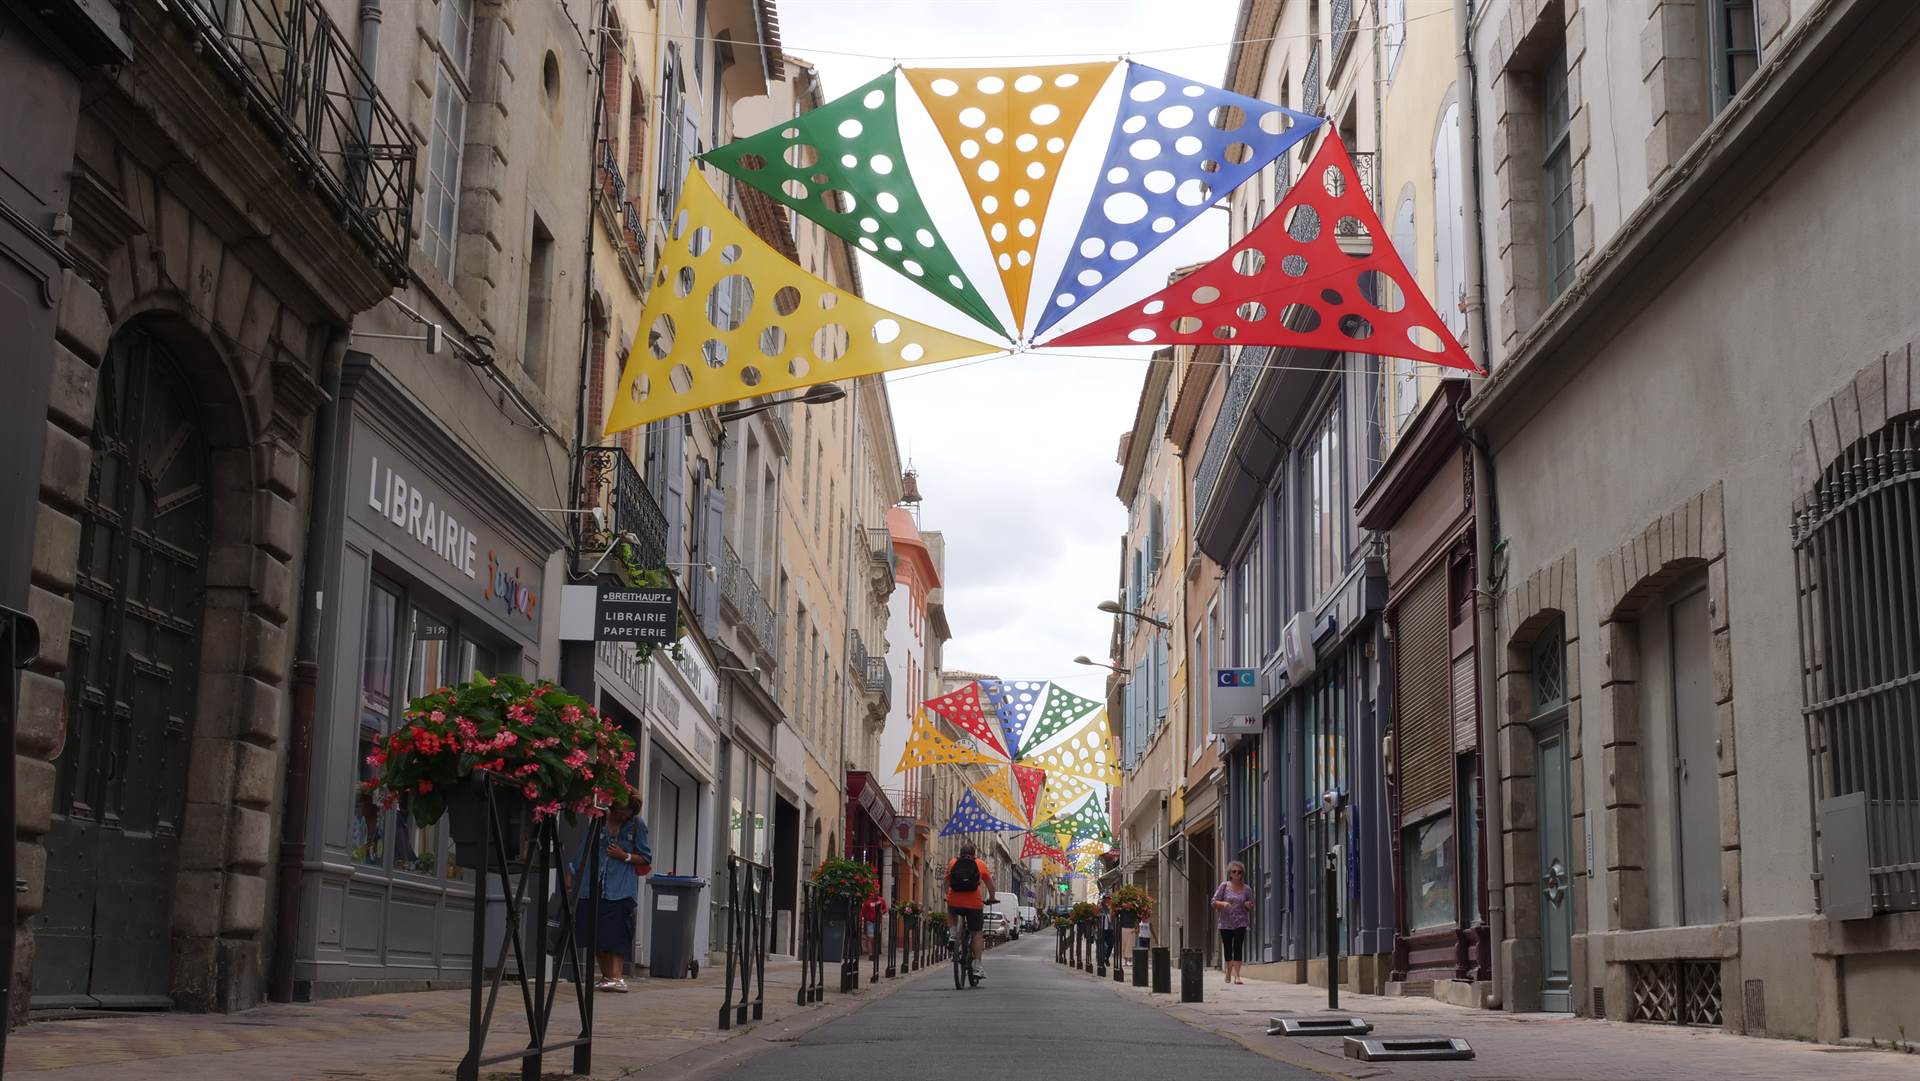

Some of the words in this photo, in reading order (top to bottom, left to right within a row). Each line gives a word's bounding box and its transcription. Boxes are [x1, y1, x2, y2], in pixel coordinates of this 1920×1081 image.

[369, 456, 477, 580] LIBRAIRIE
[608, 592, 667, 602] BREITHAUPT
[605, 612, 667, 622] LIBRAIRIE
[603, 627, 667, 637] PAPETERIE
[1220, 672, 1252, 685] CIC
